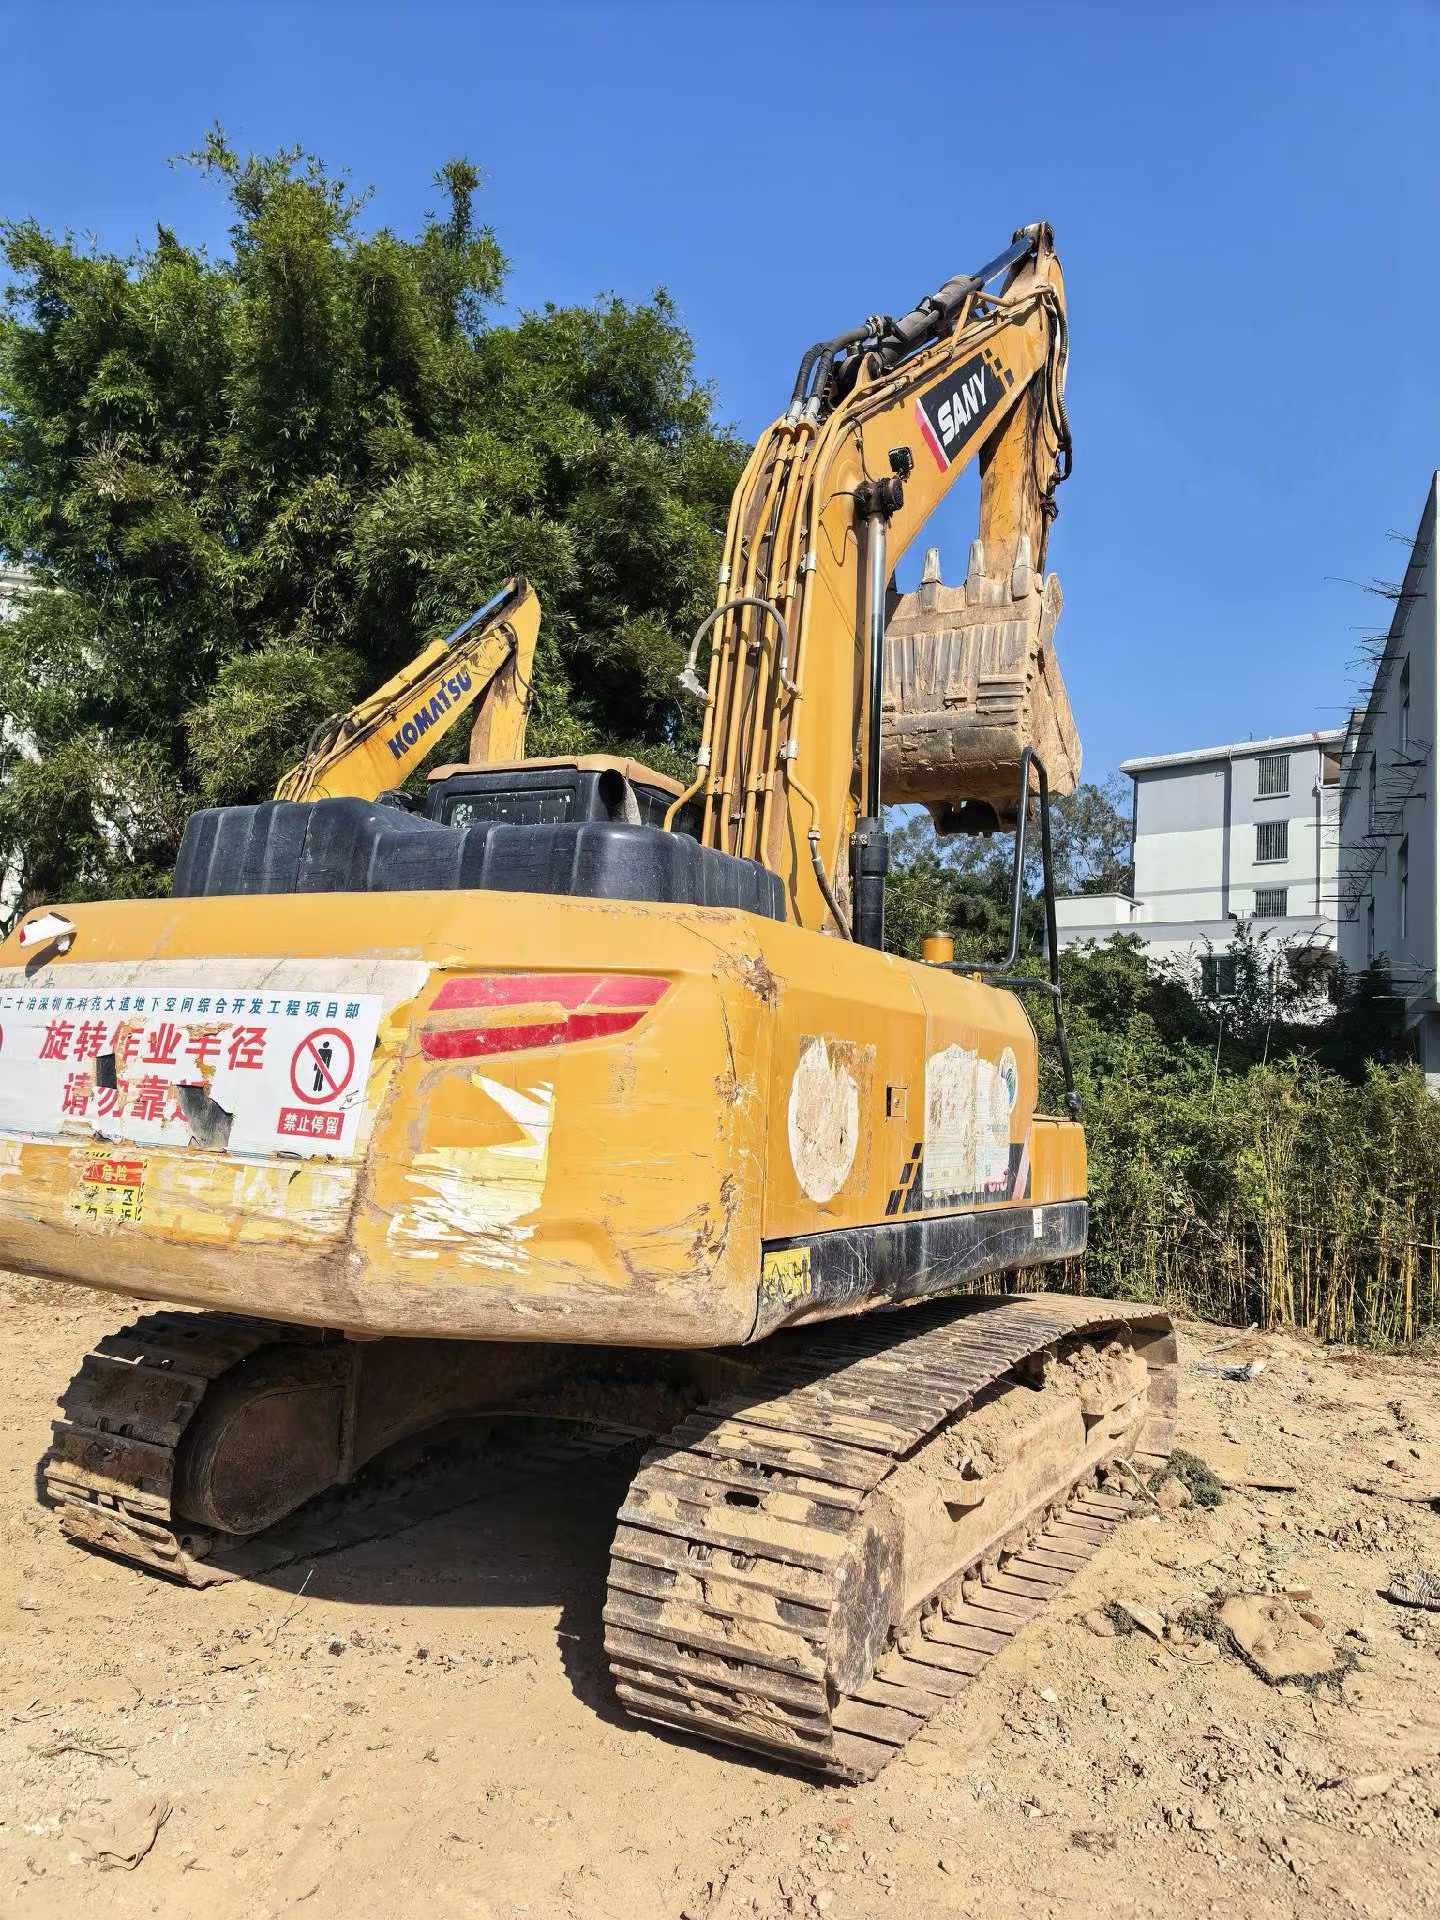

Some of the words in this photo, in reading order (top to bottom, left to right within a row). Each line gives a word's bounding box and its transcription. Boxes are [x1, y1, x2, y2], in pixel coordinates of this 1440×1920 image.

[937, 365, 987, 446] SANY
[386, 667, 472, 760] KOMATSU
[38, 1019, 268, 1071] 旋转作业半径
[61, 1071, 211, 1123] 请勿靠
[283, 1111, 340, 1136] 禁止停留
